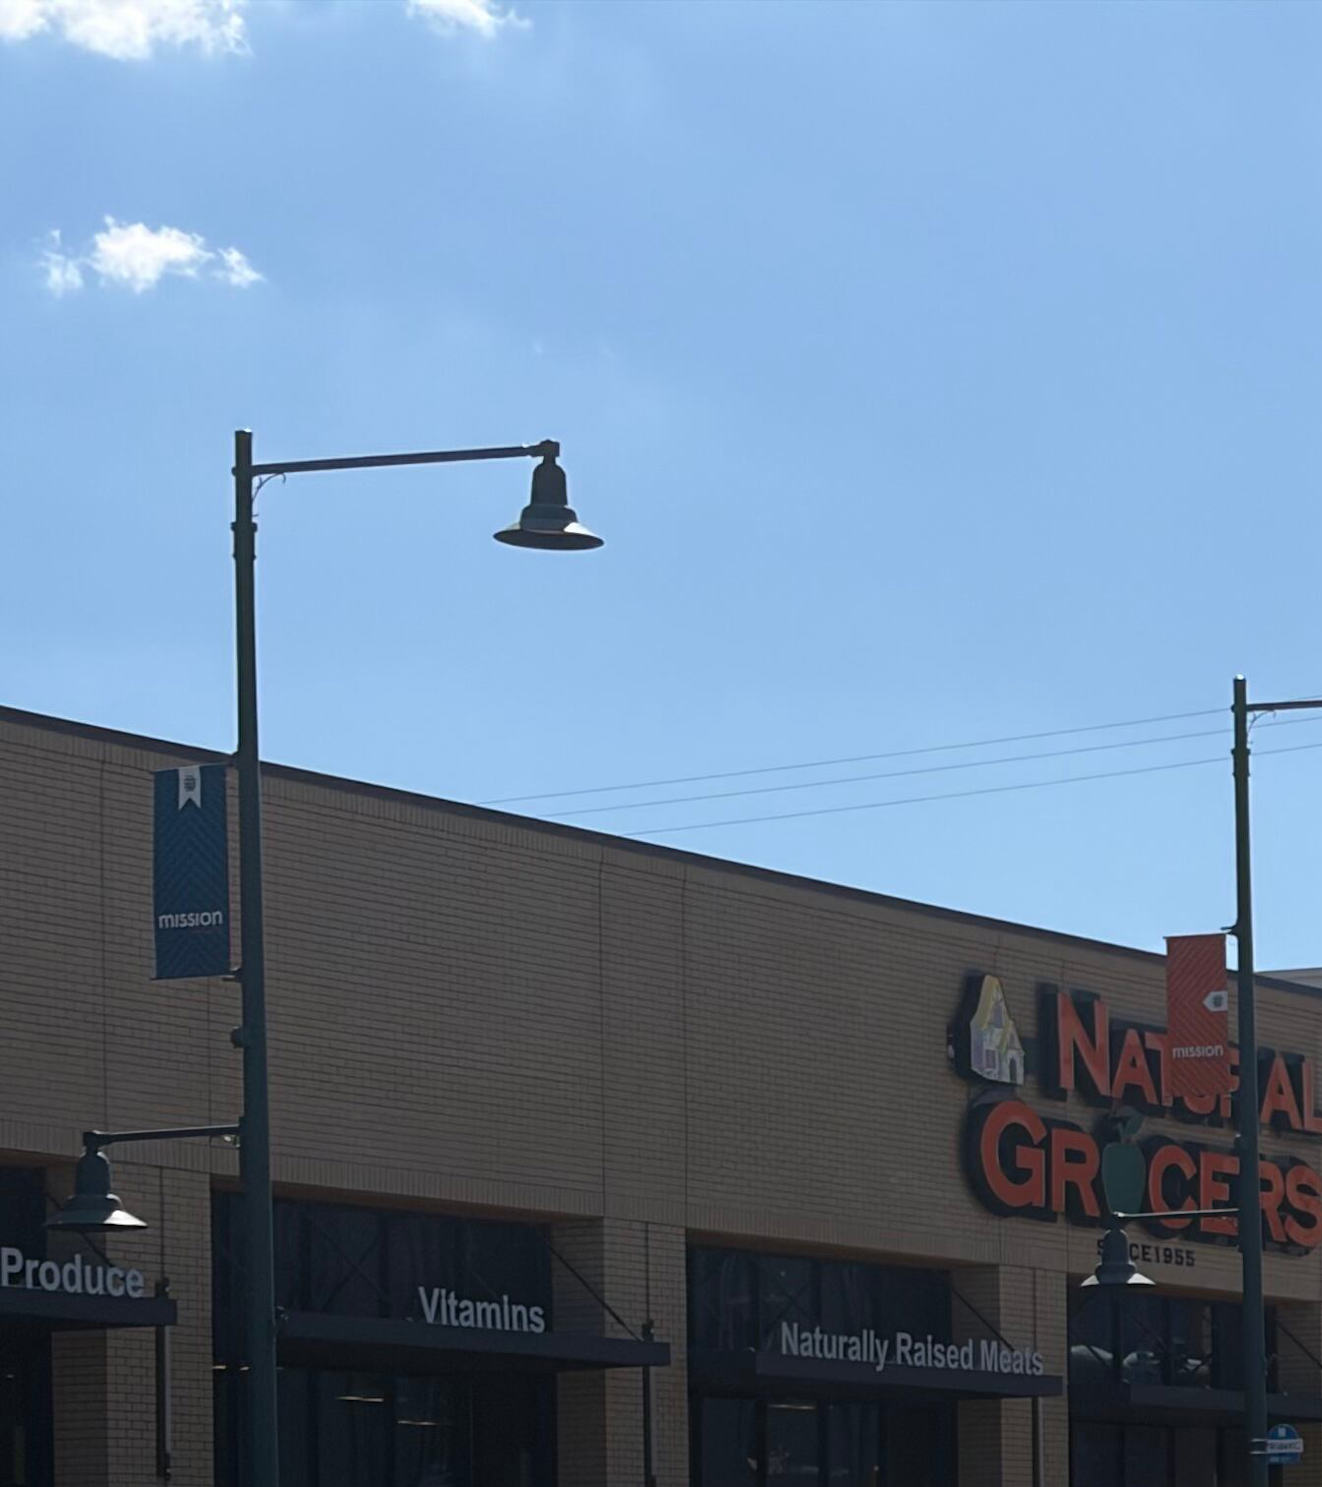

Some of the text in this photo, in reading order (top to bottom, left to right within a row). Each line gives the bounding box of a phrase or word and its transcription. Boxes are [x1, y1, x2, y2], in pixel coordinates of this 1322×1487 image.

[158, 911, 223, 929] mission
[1172, 1044, 1224, 1059] mission
[0, 1246, 145, 1298] Produce
[418, 1285, 545, 1333] Vitamins
[781, 1321, 1044, 1376] Naturally Raised Meats
